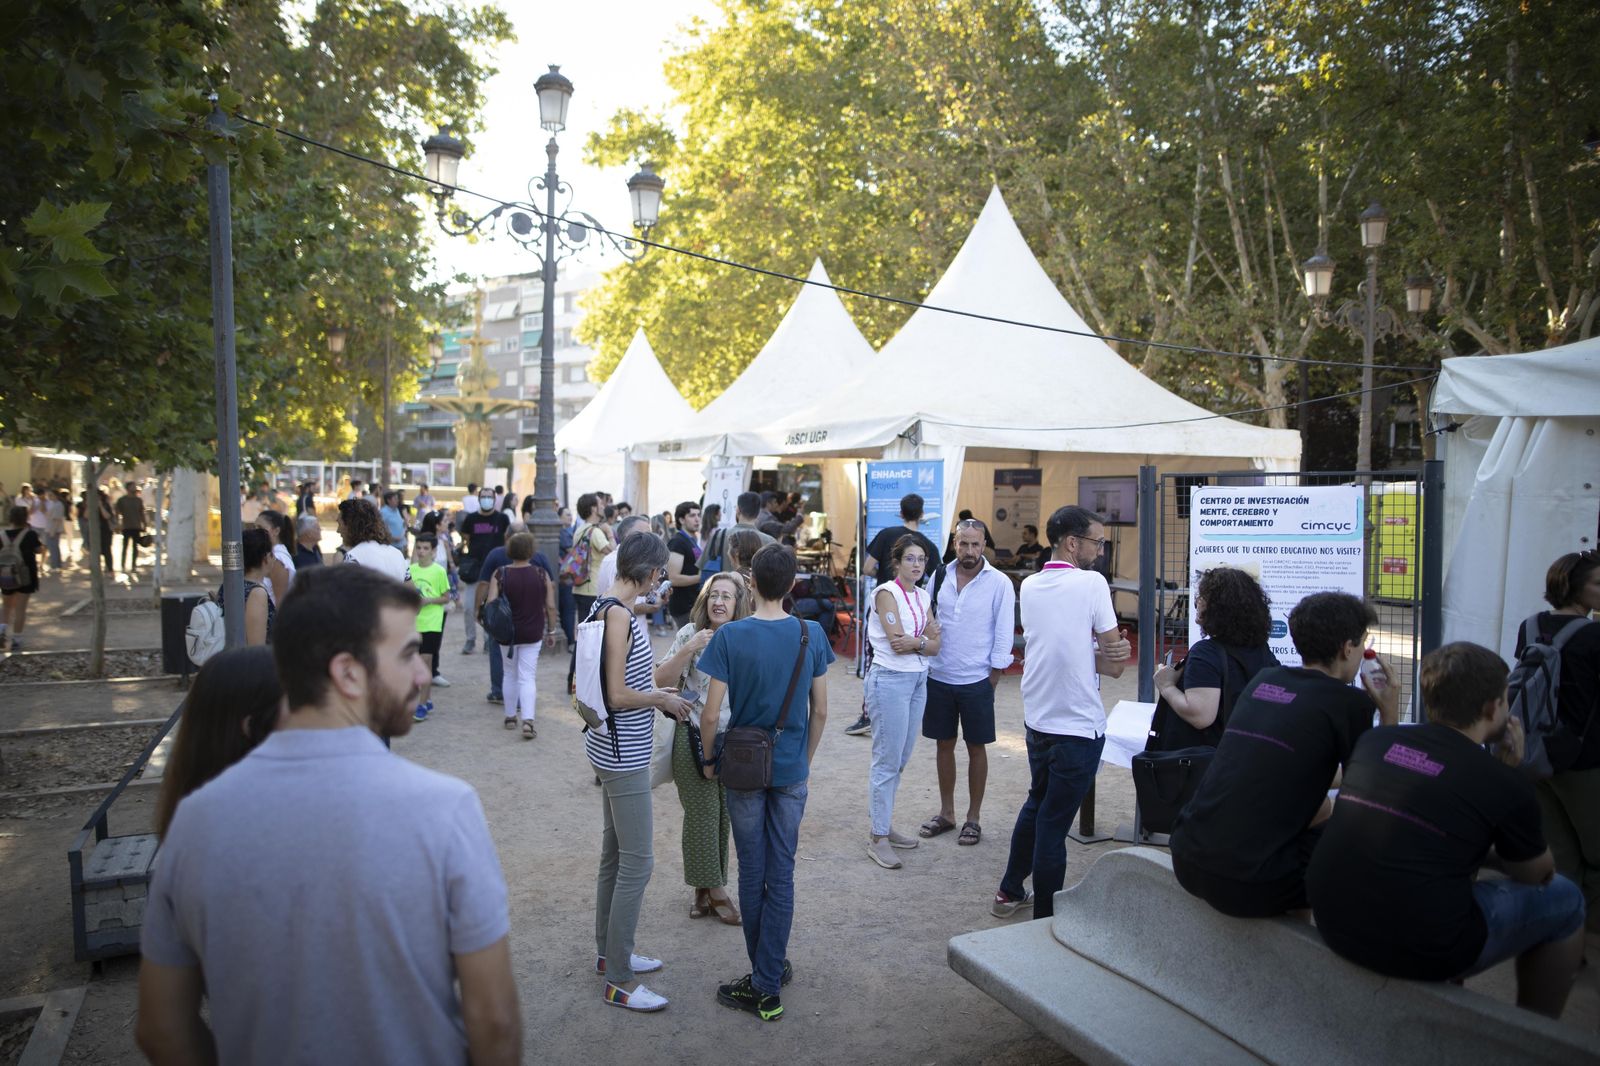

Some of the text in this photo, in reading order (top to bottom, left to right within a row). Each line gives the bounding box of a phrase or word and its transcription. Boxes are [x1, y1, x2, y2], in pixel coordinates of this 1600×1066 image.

[809, 430, 828, 443] UGR
[871, 481, 899, 491] Project
[1200, 495, 1309, 505] CENTRO DE INVESTIGACIÓN
[1200, 508, 1278, 516] MENTE, CEREBRO Y
[1199, 519, 1274, 527] COMPORTAMIENTO
[1300, 520, 1351, 532] cimcyc
[1227, 545, 1240, 554] QUE
[1242, 546, 1251, 554] TU
[1252, 546, 1279, 554] CENTRO
[1320, 547, 1334, 555] NOS
[1269, 647, 1288, 655] TROS
